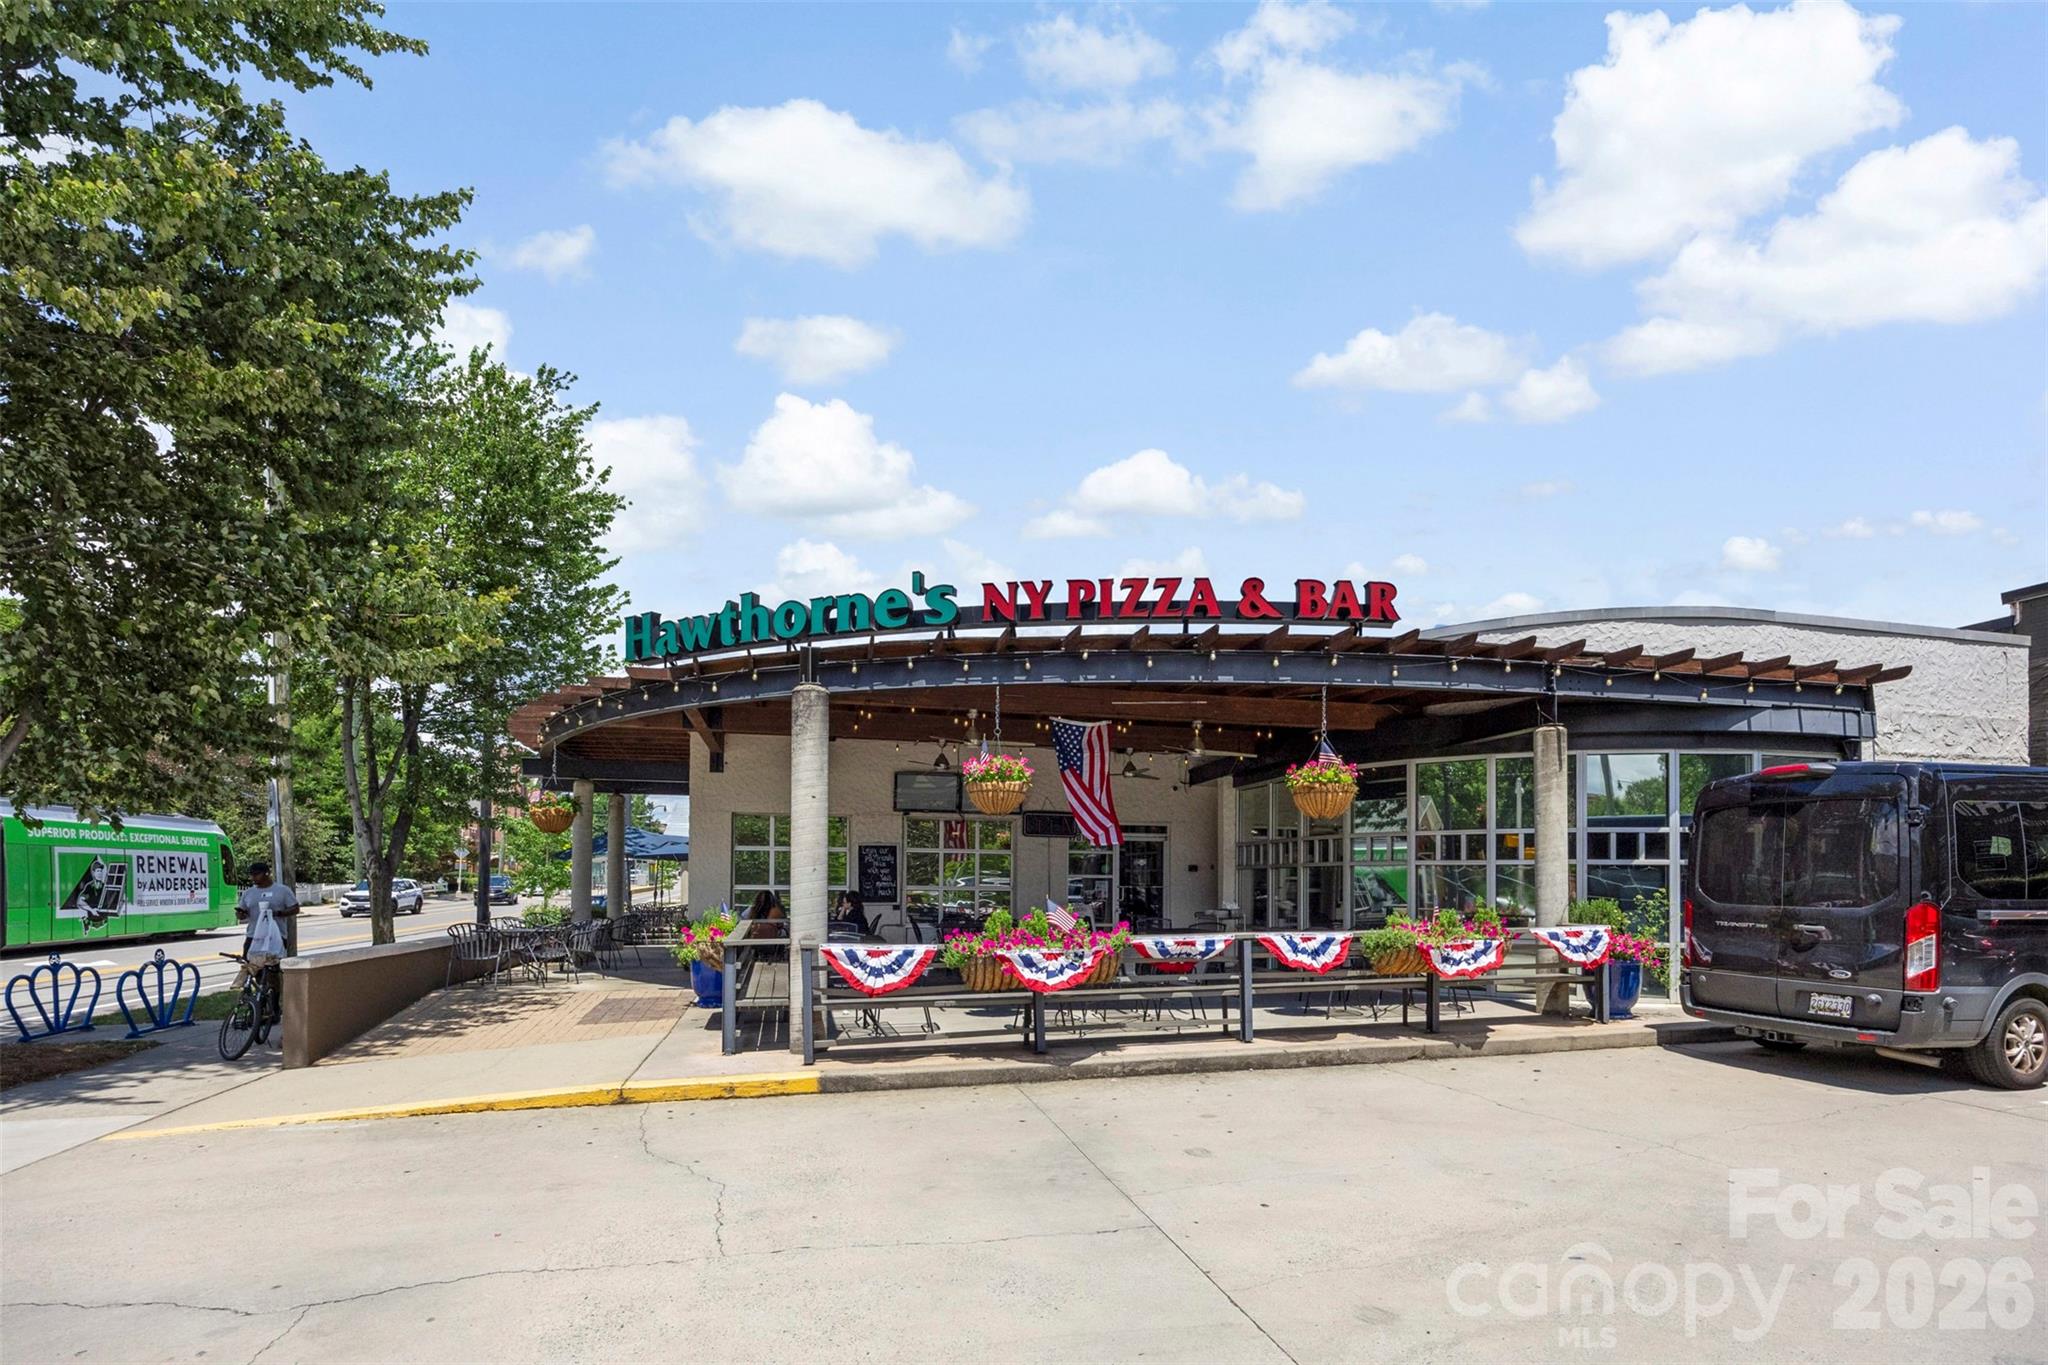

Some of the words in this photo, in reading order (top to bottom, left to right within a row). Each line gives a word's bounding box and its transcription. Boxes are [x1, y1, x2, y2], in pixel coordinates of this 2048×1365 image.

[624, 571, 959, 662] Hawthorne's
[982, 580, 1053, 622] NY
[1066, 577, 1222, 619] PIZZA
[1237, 577, 1286, 620] &
[1295, 579, 1401, 622] BAR
[27, 826, 77, 839] SUPERIOR
[130, 832, 180, 845] EXCEPTIONAL
[137, 855, 207, 874] RENEWAL
[137, 879, 148, 891] by
[148, 877, 207, 892] ANDERSEN
[1715, 920, 1755, 928] TRANSIT
